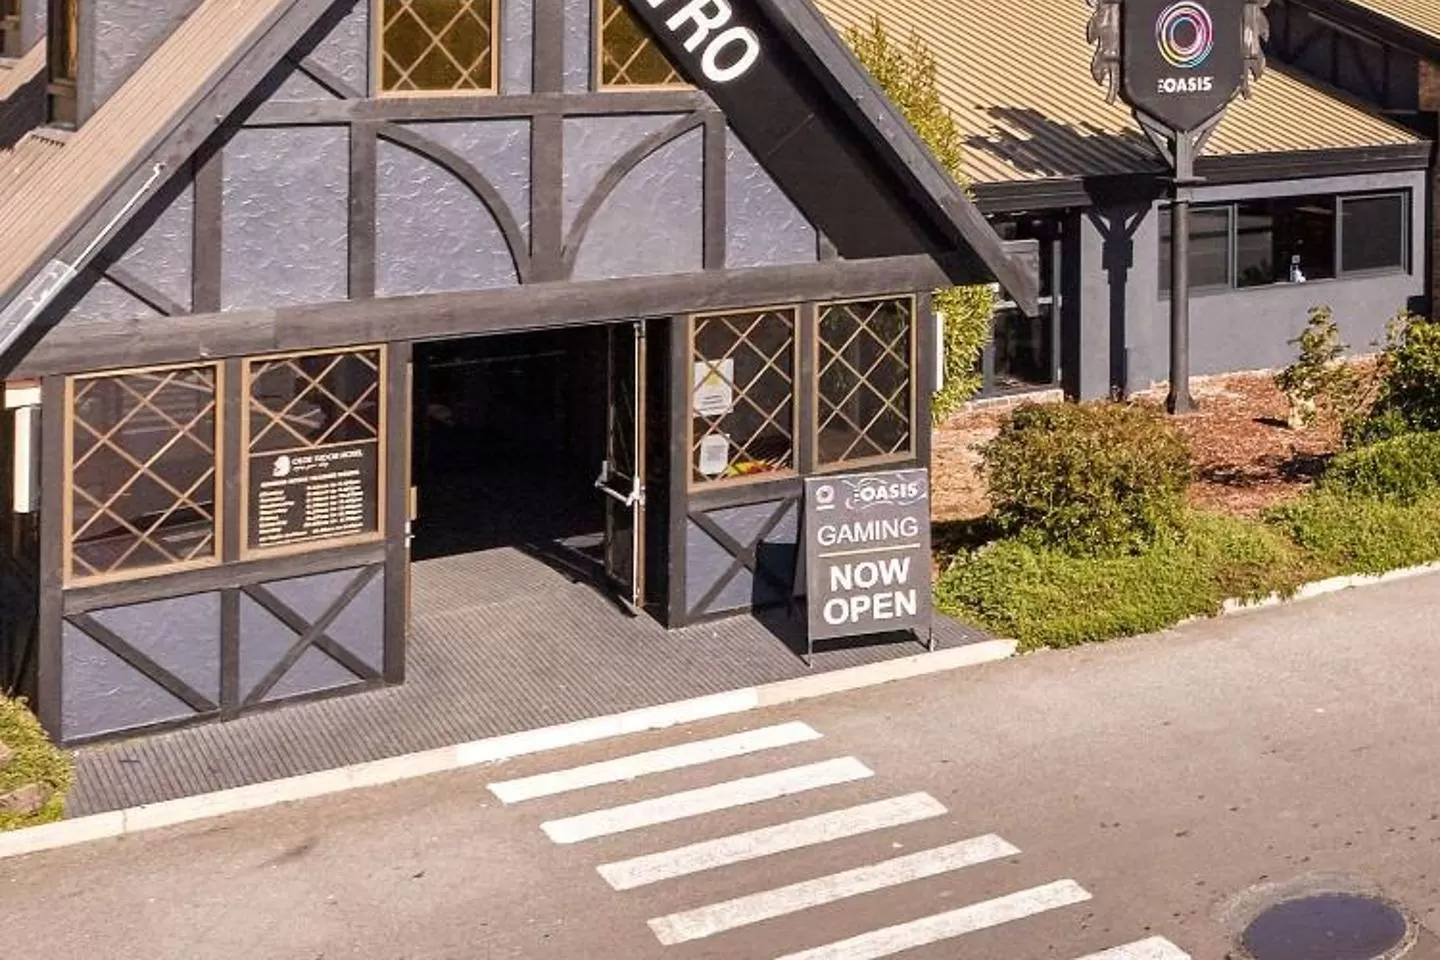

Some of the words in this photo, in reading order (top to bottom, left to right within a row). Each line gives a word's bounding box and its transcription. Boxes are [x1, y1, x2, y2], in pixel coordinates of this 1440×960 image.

[1164, 76, 1213, 93] OASIS
[859, 483, 918, 502] OASIS
[817, 516, 919, 546] GAMING
[830, 556, 911, 592] NOW
[823, 589, 917, 625] OPEN
